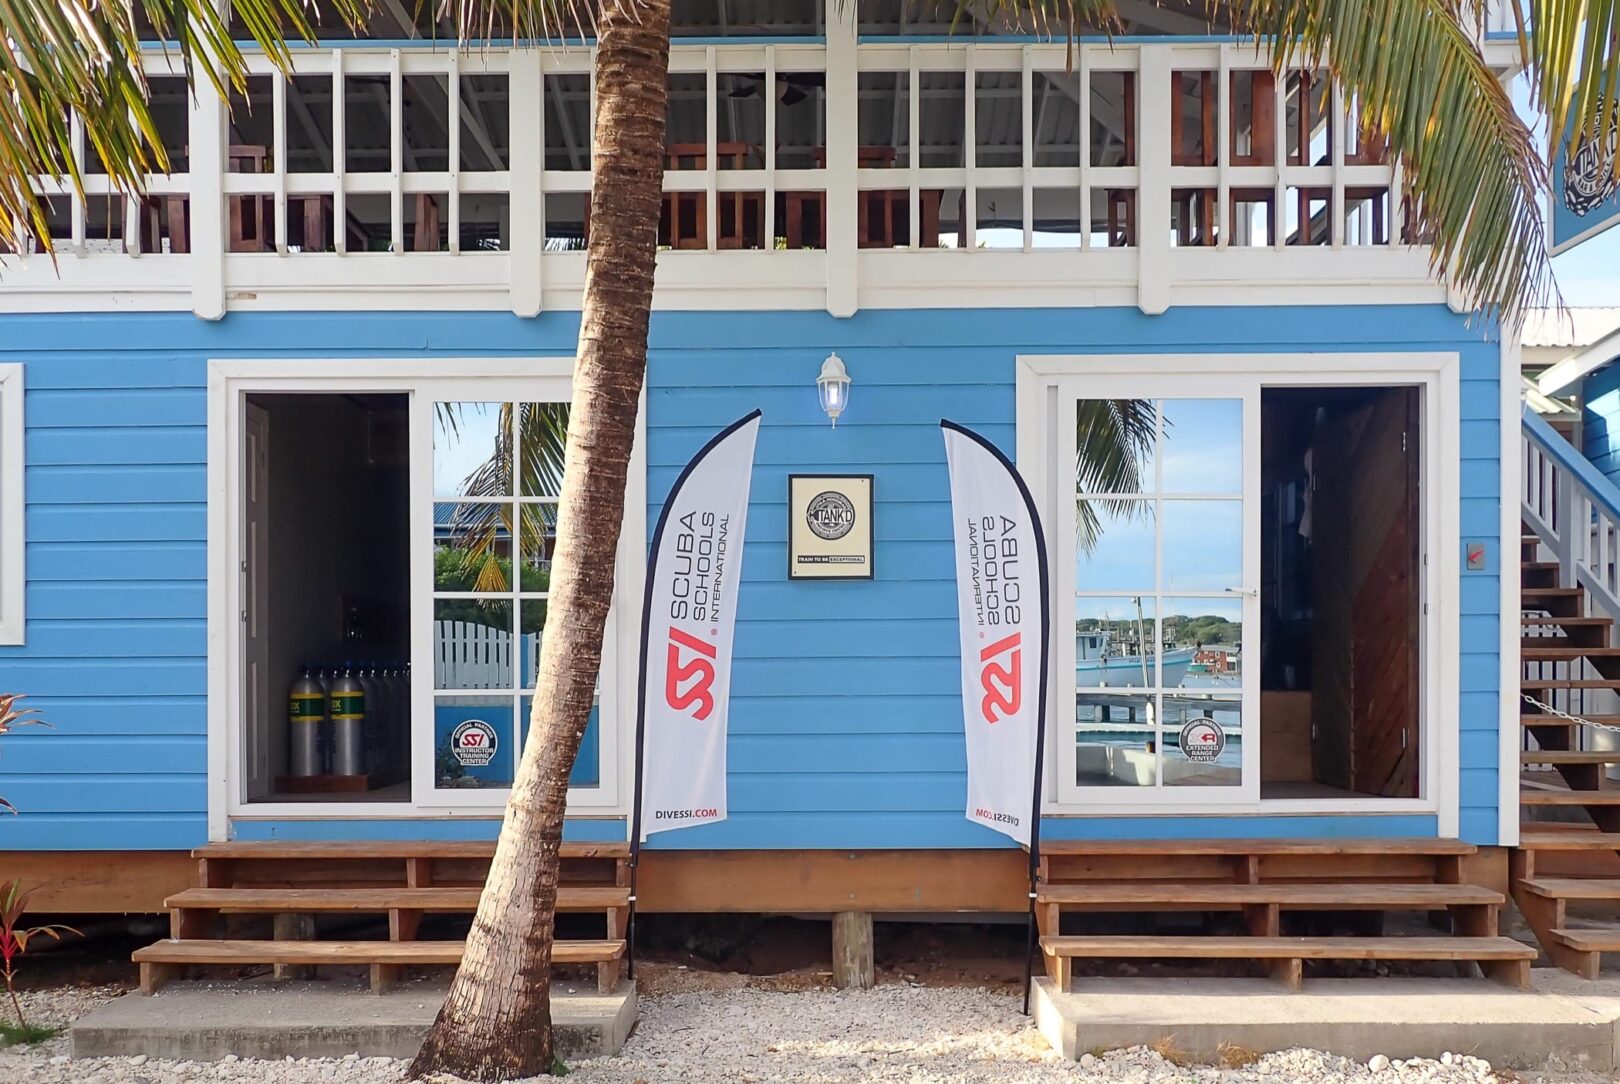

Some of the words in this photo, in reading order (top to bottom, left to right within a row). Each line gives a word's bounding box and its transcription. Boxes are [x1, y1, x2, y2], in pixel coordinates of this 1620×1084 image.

[670, 511, 697, 620] SCUBA
[693, 512, 715, 621] SCHOOLS
[711, 514, 729, 622] INTERNATIONAL
[665, 625, 717, 721] SSI
[462, 733, 485, 746] SSI
[655, 809, 718, 819] DIVESSI.COM
